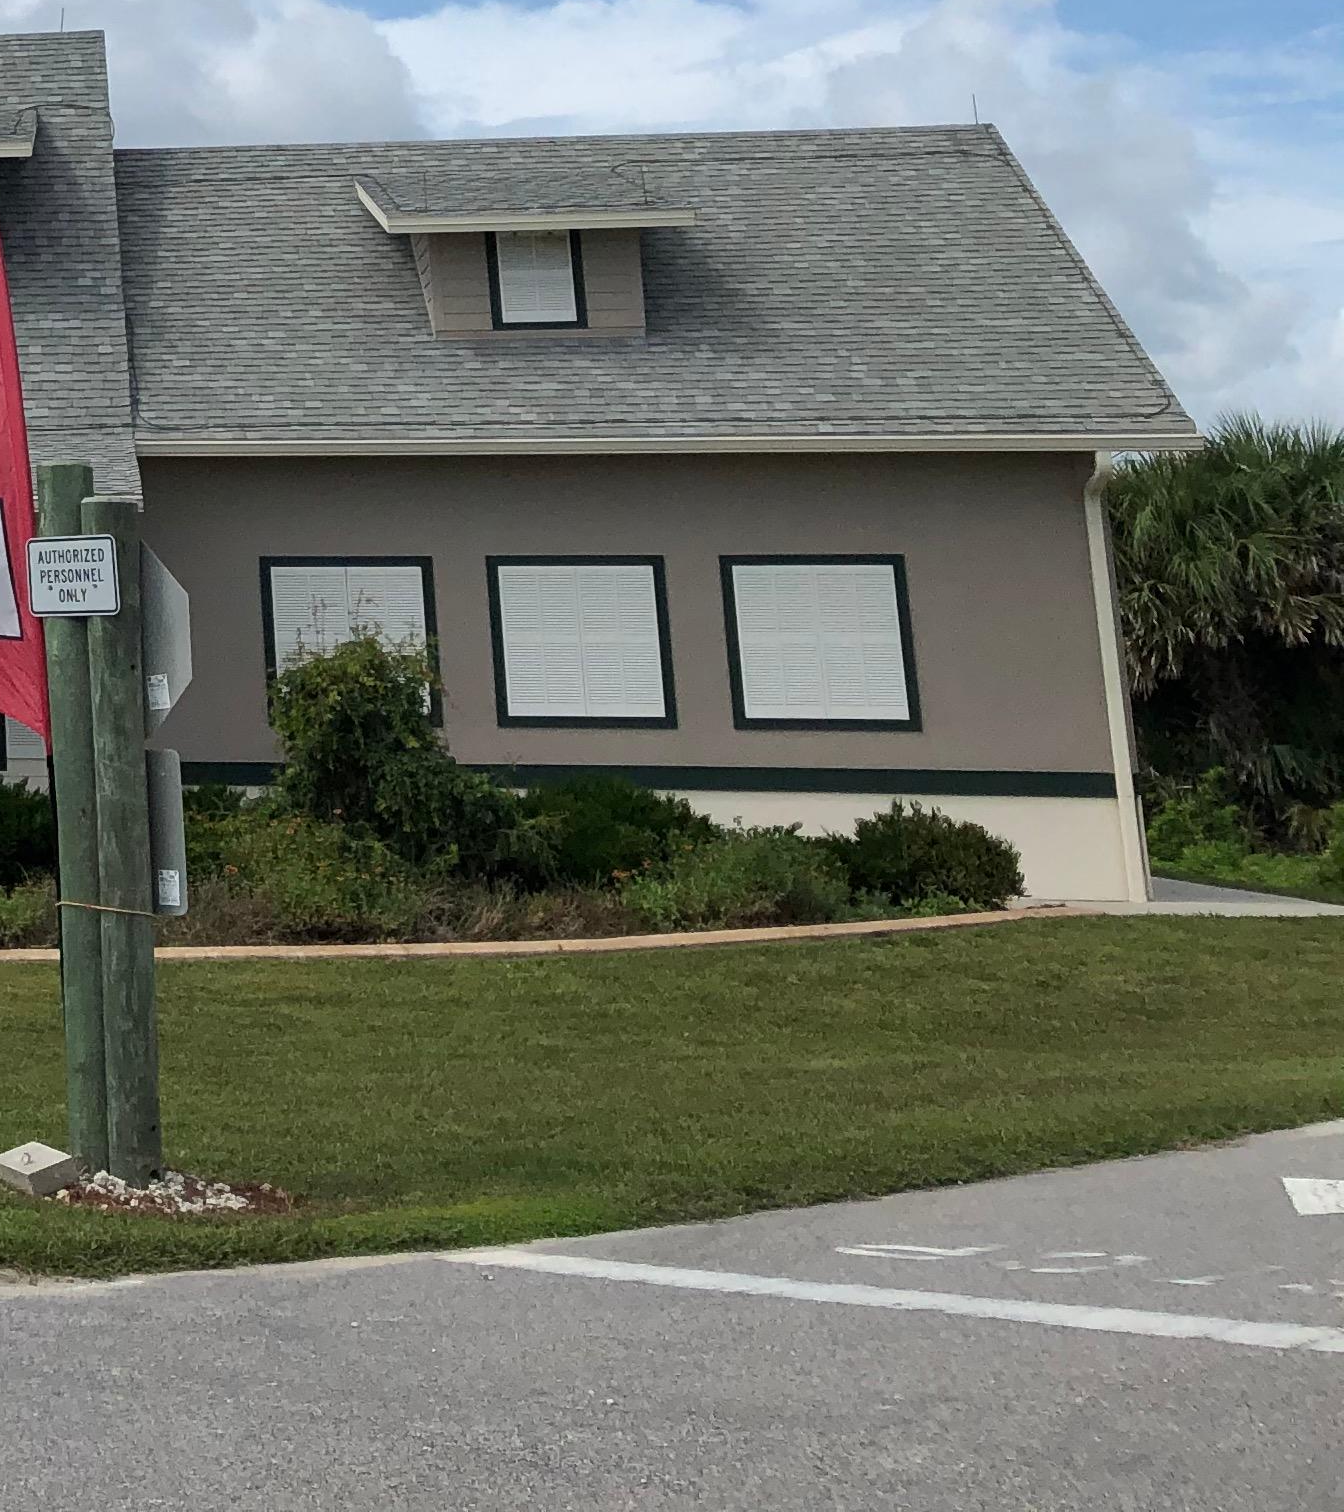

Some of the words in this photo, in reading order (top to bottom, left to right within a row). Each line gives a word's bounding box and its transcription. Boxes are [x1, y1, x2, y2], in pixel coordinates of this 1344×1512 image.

[38, 548, 105, 564] AUTHORIZED
[40, 568, 104, 584] PERSONNEL
[58, 588, 87, 603] ONLY
